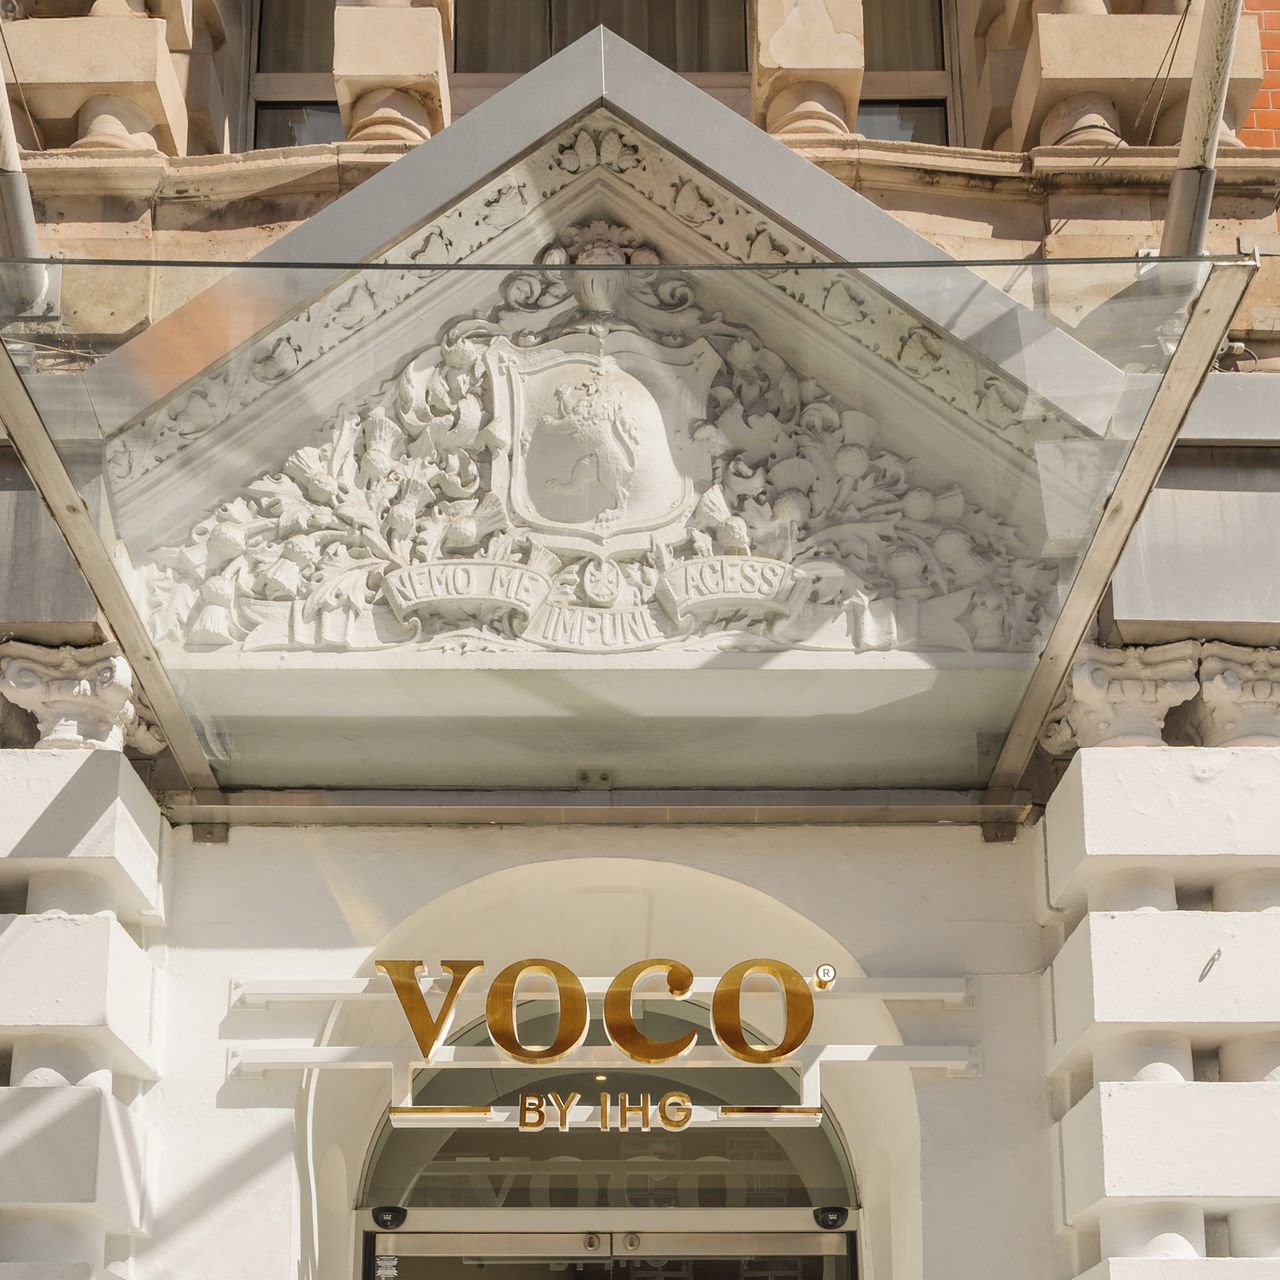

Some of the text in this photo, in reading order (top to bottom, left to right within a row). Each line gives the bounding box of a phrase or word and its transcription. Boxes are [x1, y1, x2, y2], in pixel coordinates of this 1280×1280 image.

[394, 565, 541, 607] NEMO ME
[518, 1091, 693, 1132] BY IHG
